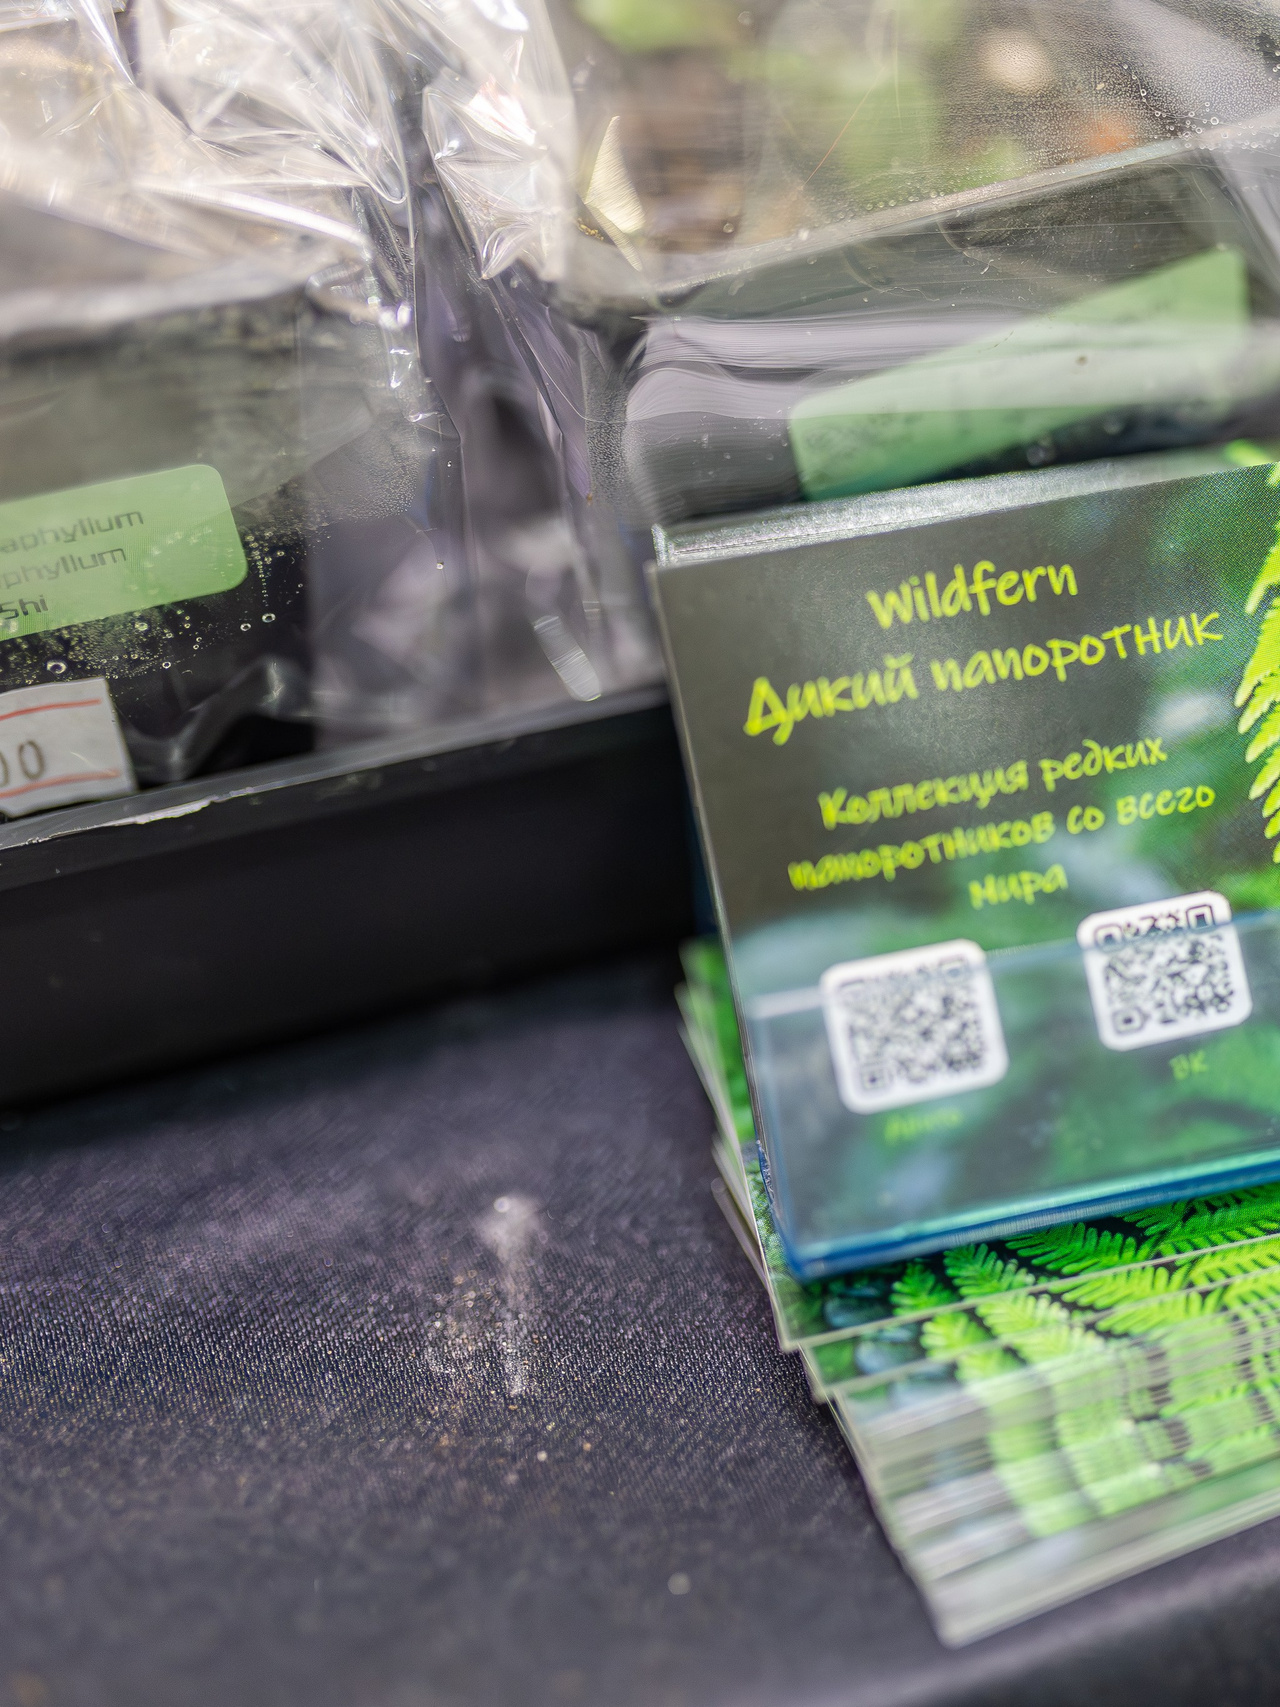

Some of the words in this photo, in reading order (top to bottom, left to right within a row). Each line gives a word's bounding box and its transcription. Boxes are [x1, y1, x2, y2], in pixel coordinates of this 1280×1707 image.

[743, 653, 919, 745] Дикий
[930, 611, 1223, 692] папоротник
[818, 760, 1028, 830] Коллекция
[1040, 737, 1167, 792] редких
[788, 811, 1056, 891] папоротников
[1066, 805, 1104, 834] со
[1116, 785, 1215, 825] всего
[968, 863, 1068, 909] мира
